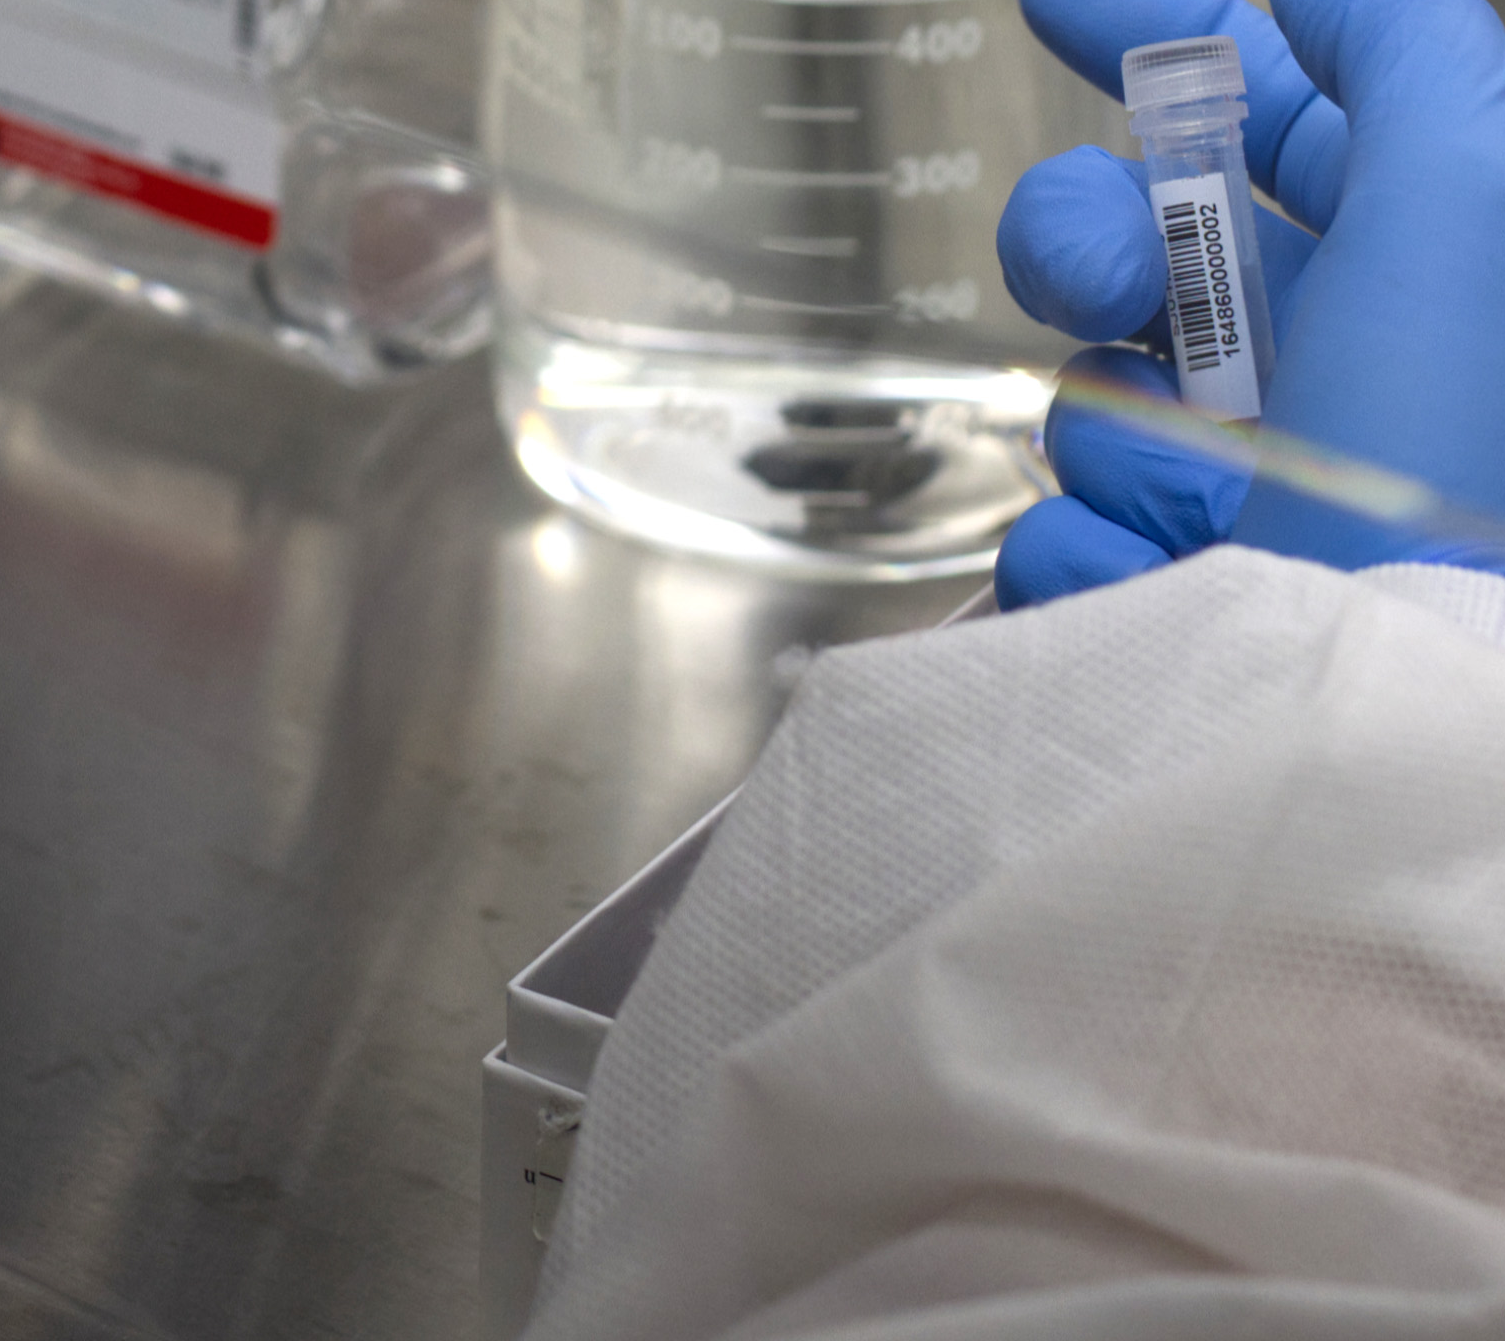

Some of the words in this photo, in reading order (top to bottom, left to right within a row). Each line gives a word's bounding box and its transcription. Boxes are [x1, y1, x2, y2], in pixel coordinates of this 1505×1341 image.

[894, 19, 982, 64] 400
[894, 149, 980, 198] 300
[1200, 202, 1241, 358] 164860000002
